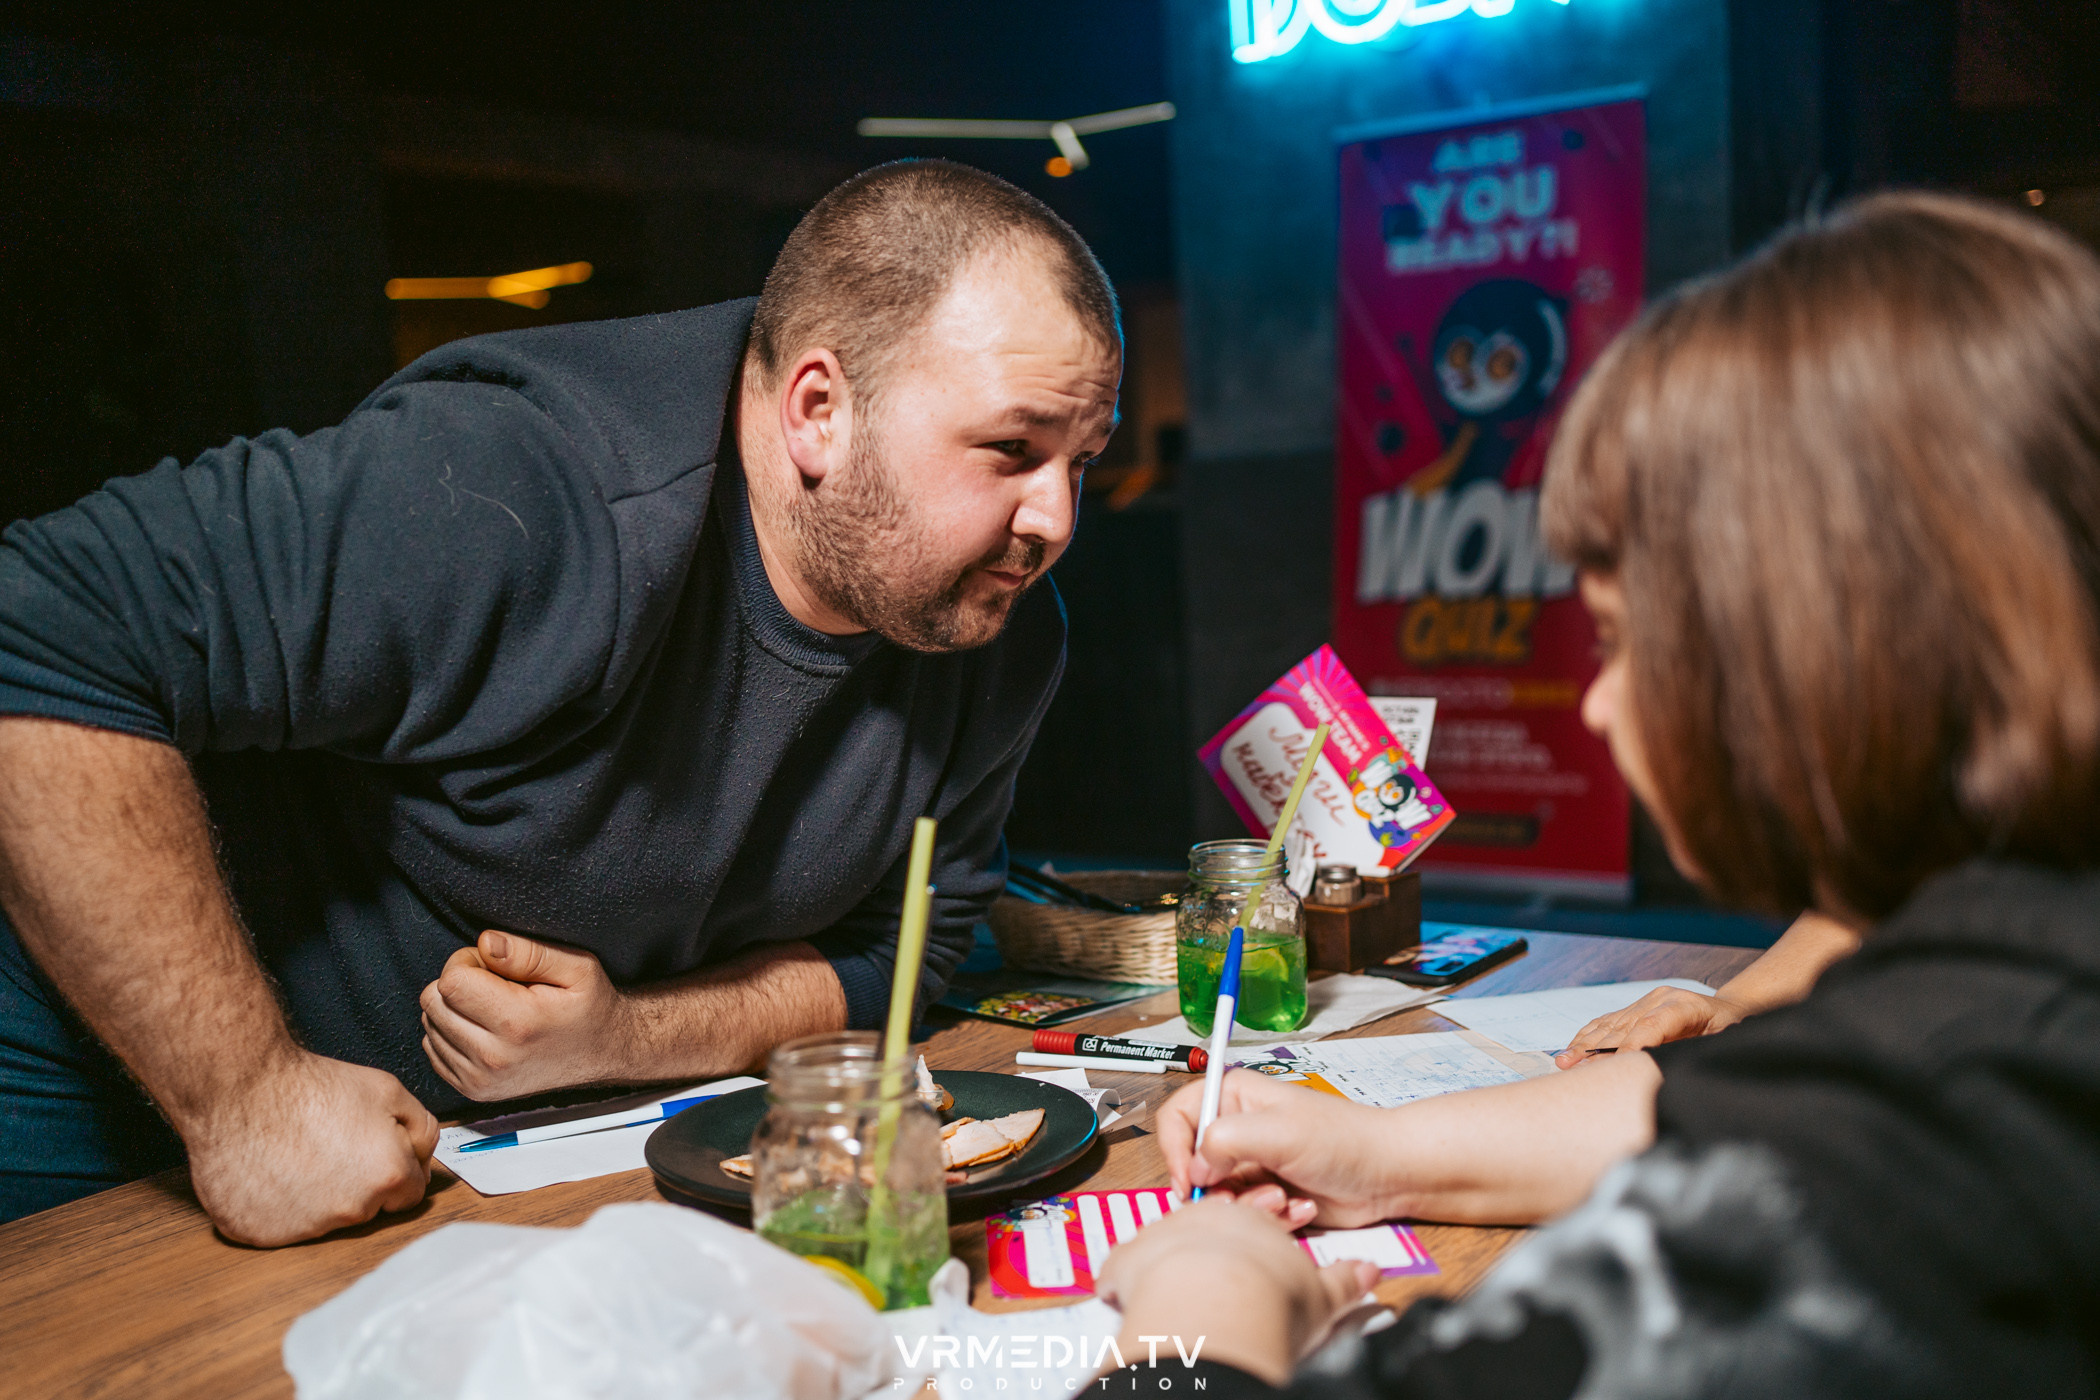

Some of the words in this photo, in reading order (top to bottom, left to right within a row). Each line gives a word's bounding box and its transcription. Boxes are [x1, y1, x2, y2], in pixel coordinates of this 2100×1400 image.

[1410, 167, 1556, 228] YOU
[1300, 681, 1335, 723] WOW
[1331, 720, 1363, 765] TEAM
[1100, 1040, 1146, 1057] Permanent
[1144, 1046, 1175, 1060] Marker
